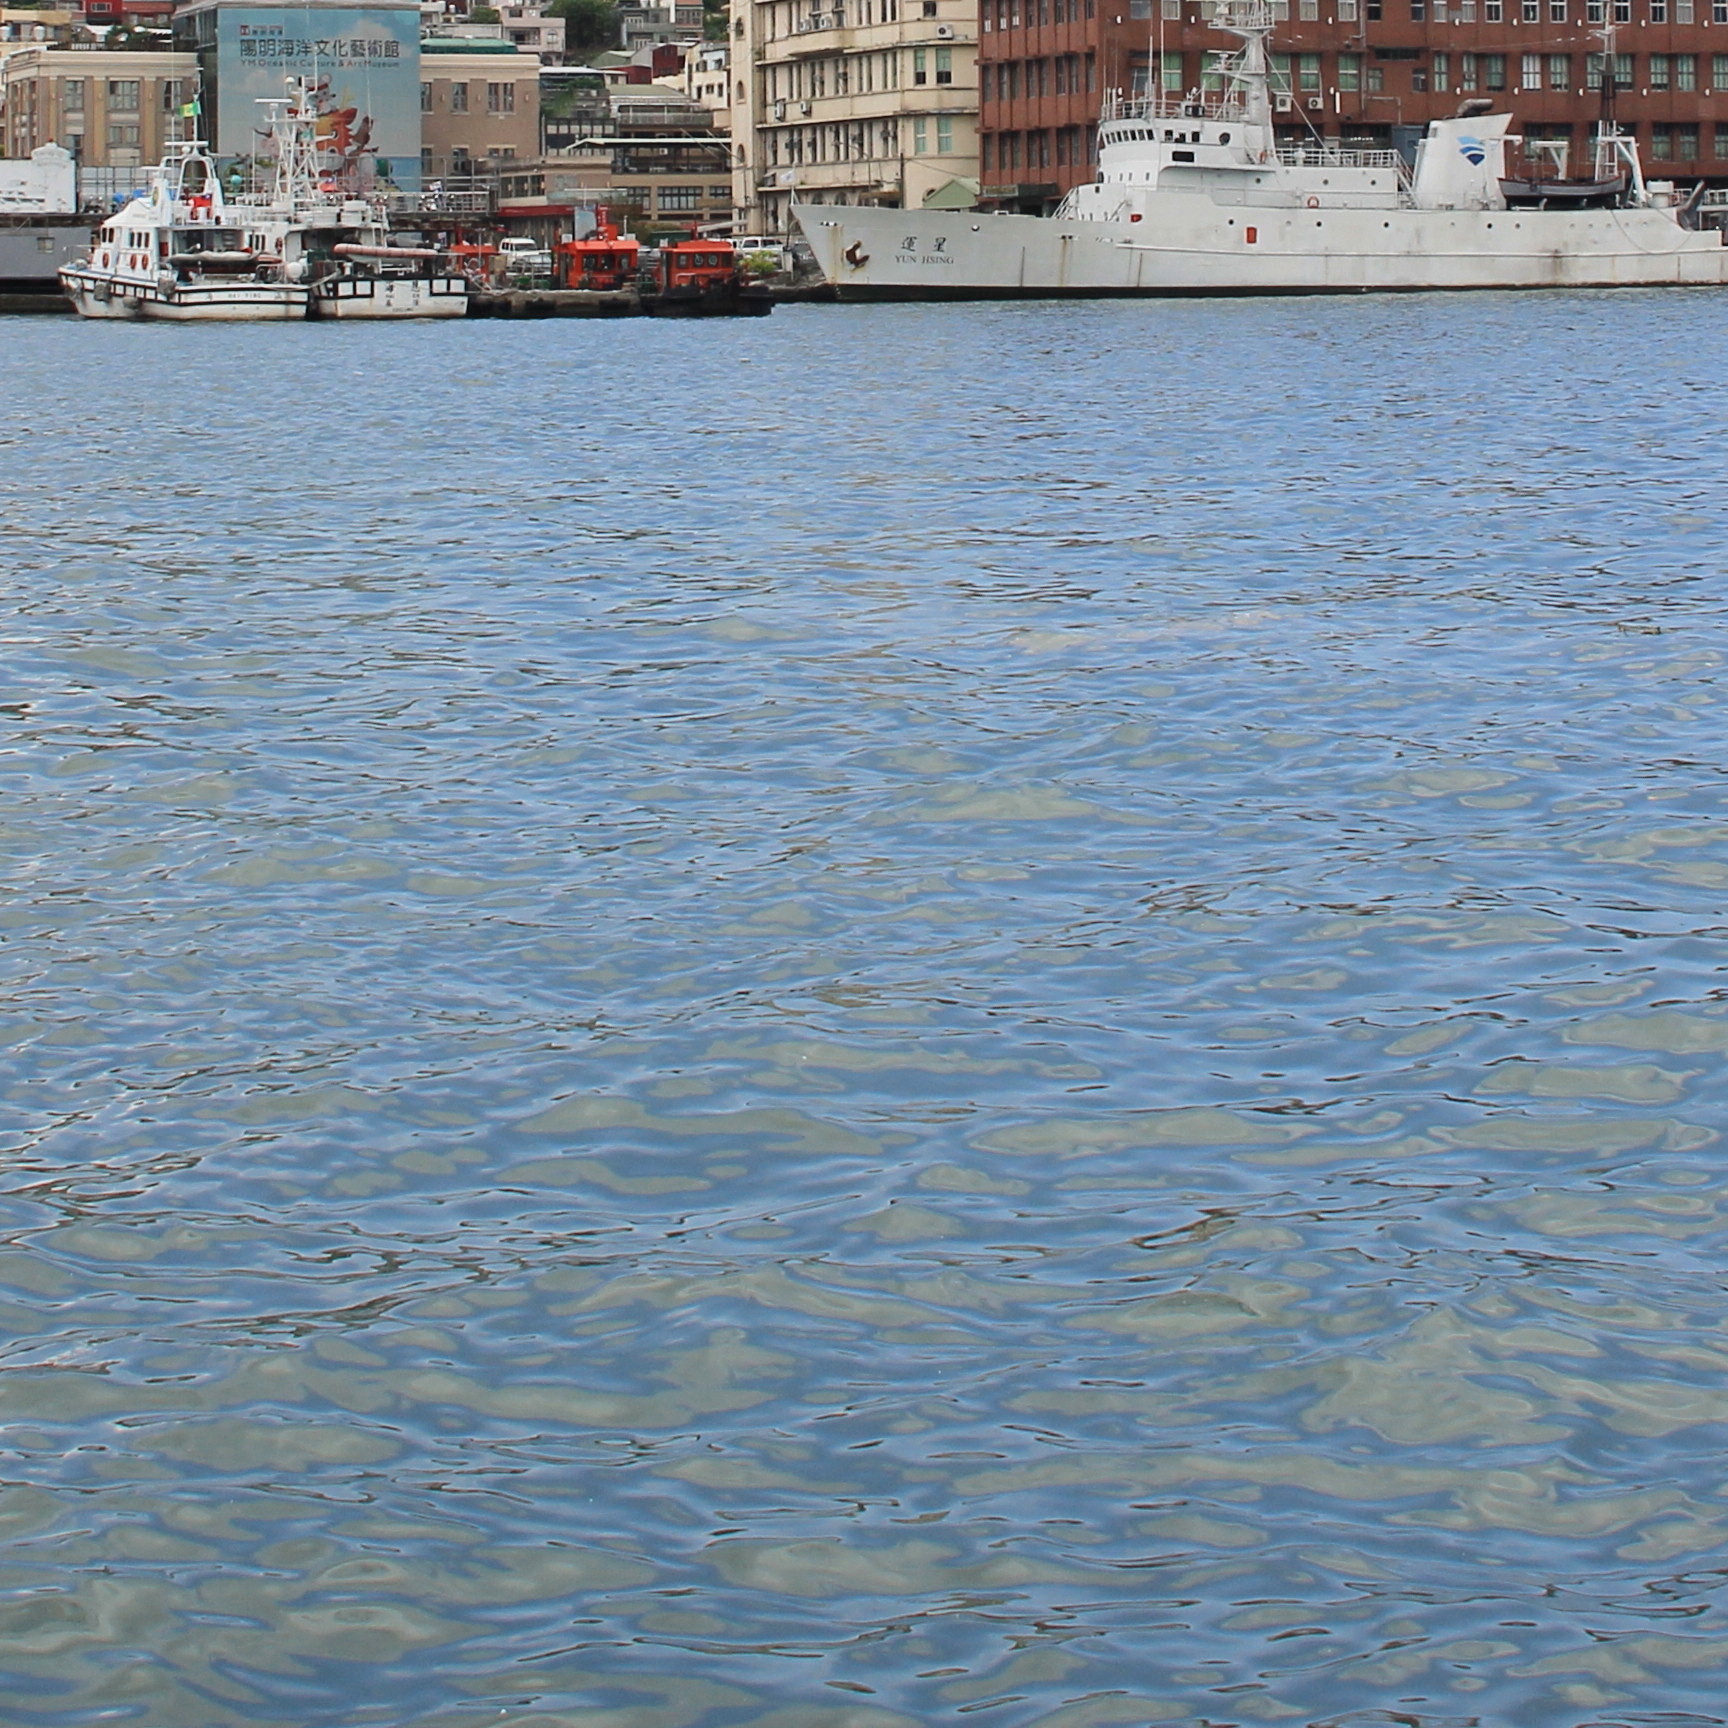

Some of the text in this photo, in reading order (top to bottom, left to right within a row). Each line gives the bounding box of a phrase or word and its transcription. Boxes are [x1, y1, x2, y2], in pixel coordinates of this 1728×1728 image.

[240, 39, 400, 58] 陽明海洋文化藝術館
[300, 59, 336, 68] Cuture
[895, 255, 954, 265] YUN HSING
